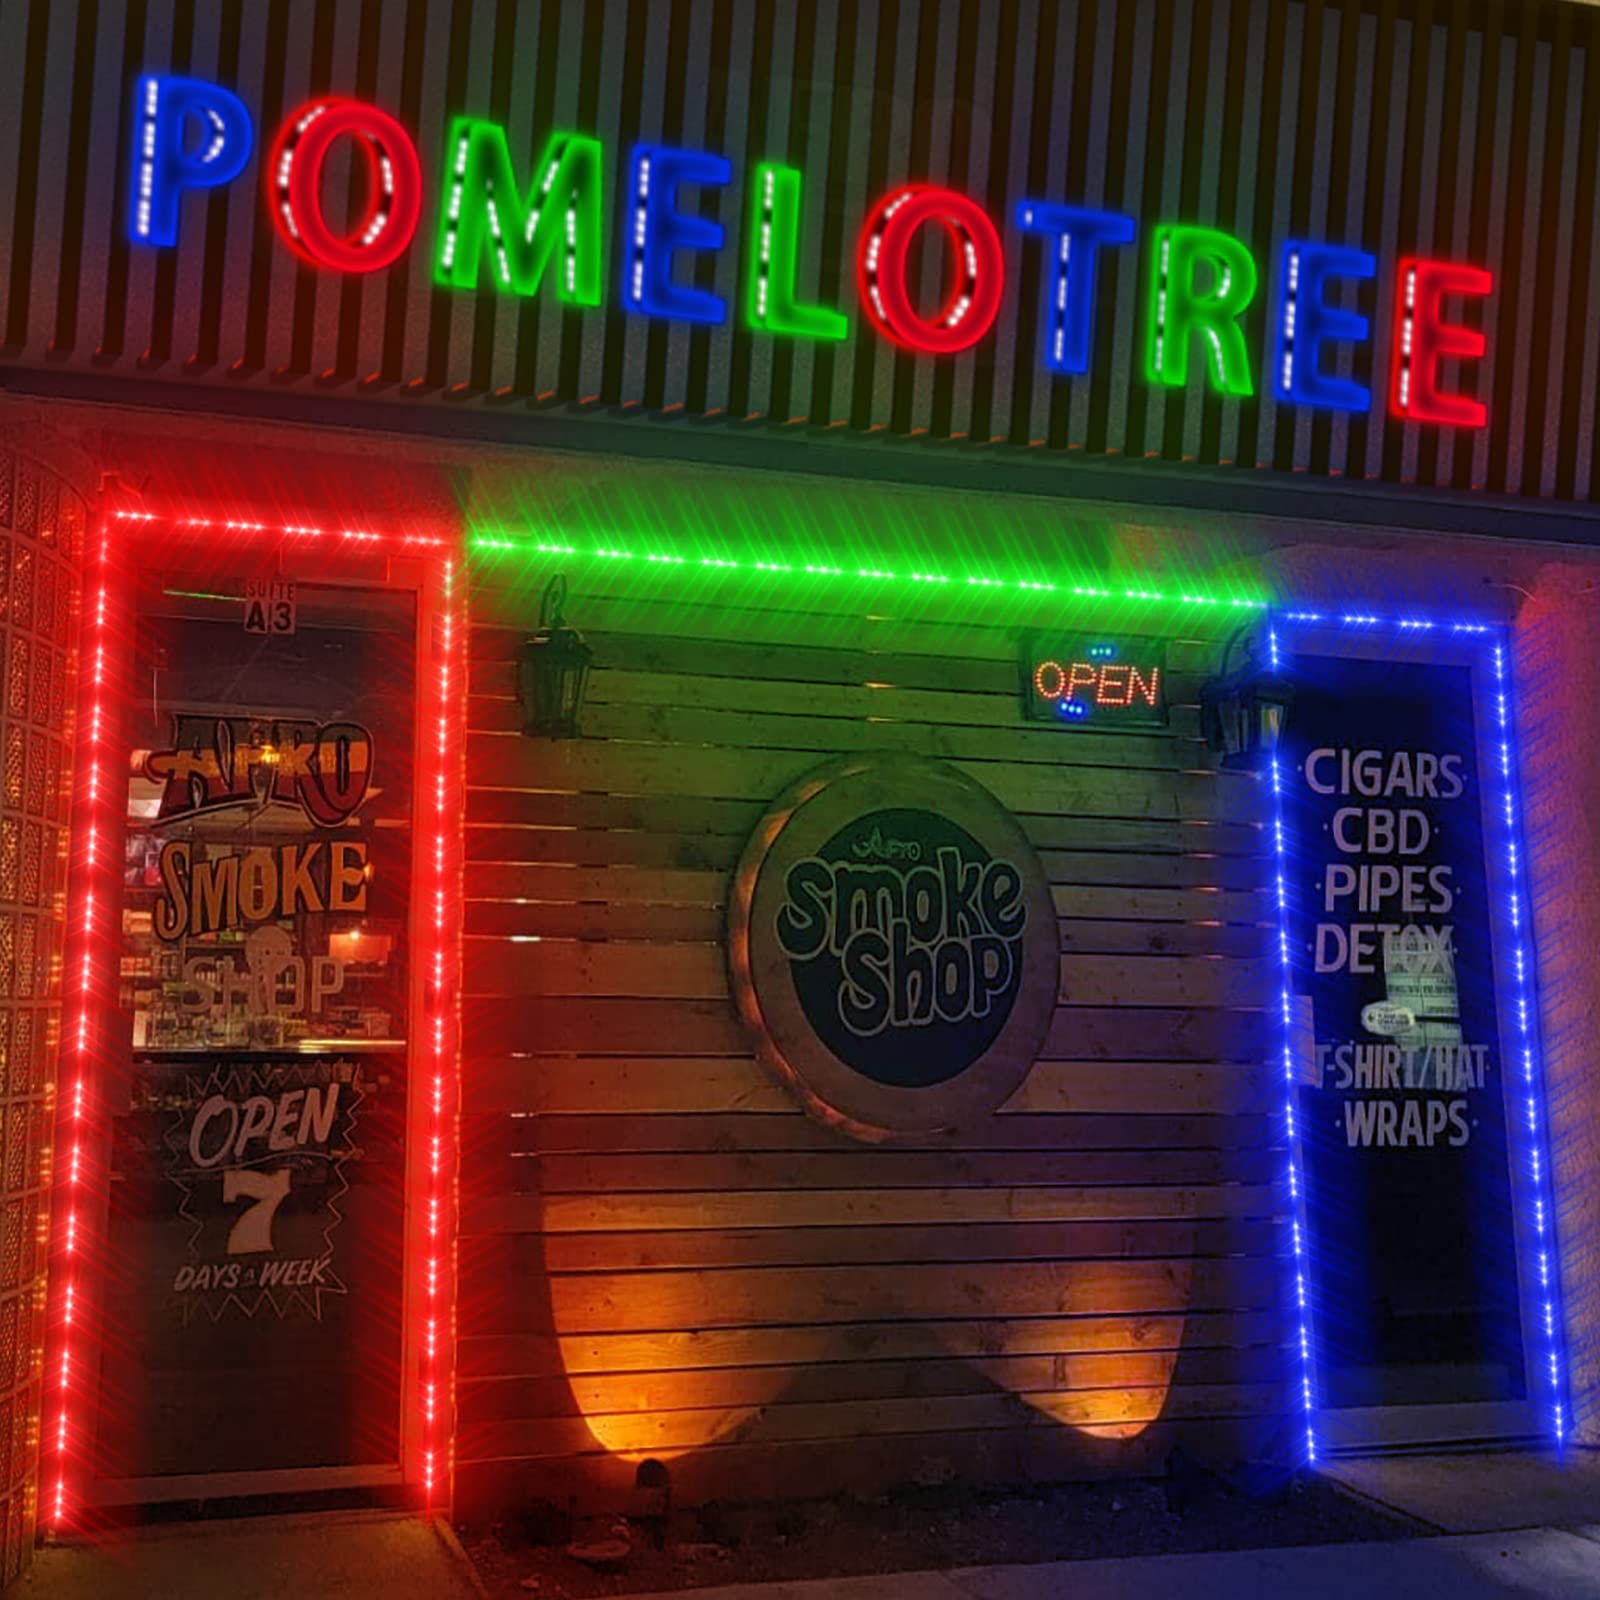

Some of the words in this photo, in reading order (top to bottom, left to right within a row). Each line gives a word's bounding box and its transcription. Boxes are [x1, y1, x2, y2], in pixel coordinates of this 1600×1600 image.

[128, 73, 1494, 428] POMELOTREE
[247, 581, 295, 600] SUITE
[246, 601, 292, 632] A3
[1036, 661, 1159, 705] OPEN
[144, 713, 374, 829] AFRO
[1305, 748, 1464, 798] CIGARS
[1332, 807, 1430, 854] CBD
[152, 840, 368, 942] SMOKE
[1325, 864, 1453, 914] PIPES
[1315, 923, 1455, 975] DETOX
[179, 956, 345, 1014] SHOP
[1313, 1043, 1489, 1092] T-SHIRT/HAT
[188, 1083, 340, 1168] OPEN
[1345, 1100, 1470, 1147] WRAPS
[222, 1169, 291, 1255] 7
[174, 1264, 241, 1291] DAYS
[259, 1258, 330, 1287] WEEK
